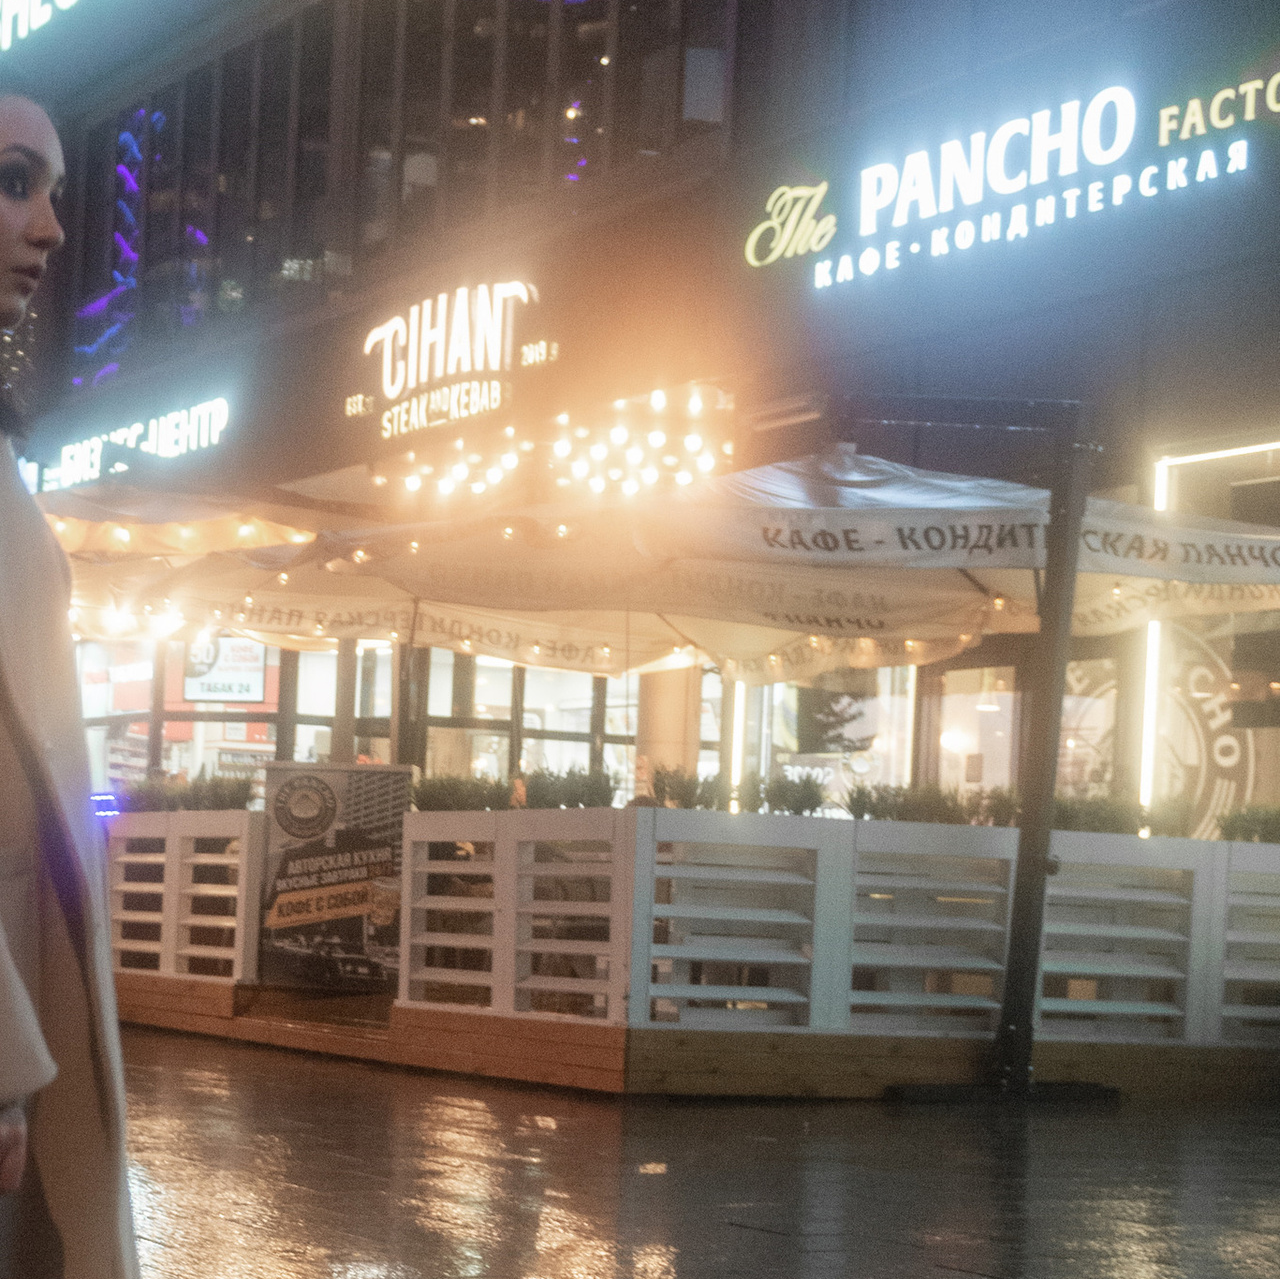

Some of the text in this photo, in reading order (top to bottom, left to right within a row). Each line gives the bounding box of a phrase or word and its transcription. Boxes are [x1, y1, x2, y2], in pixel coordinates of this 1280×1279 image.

[744, 180, 837, 269] The
[858, 86, 1138, 238] PANCHO
[814, 139, 1250, 289] КАФЕ КОНДИТЕРСКАЯ
[363, 280, 529, 401] CIHAN
[380, 392, 429, 440] STEAK
[449, 379, 503, 421] KEBAB
[761, 525, 867, 553] КАФЕ
